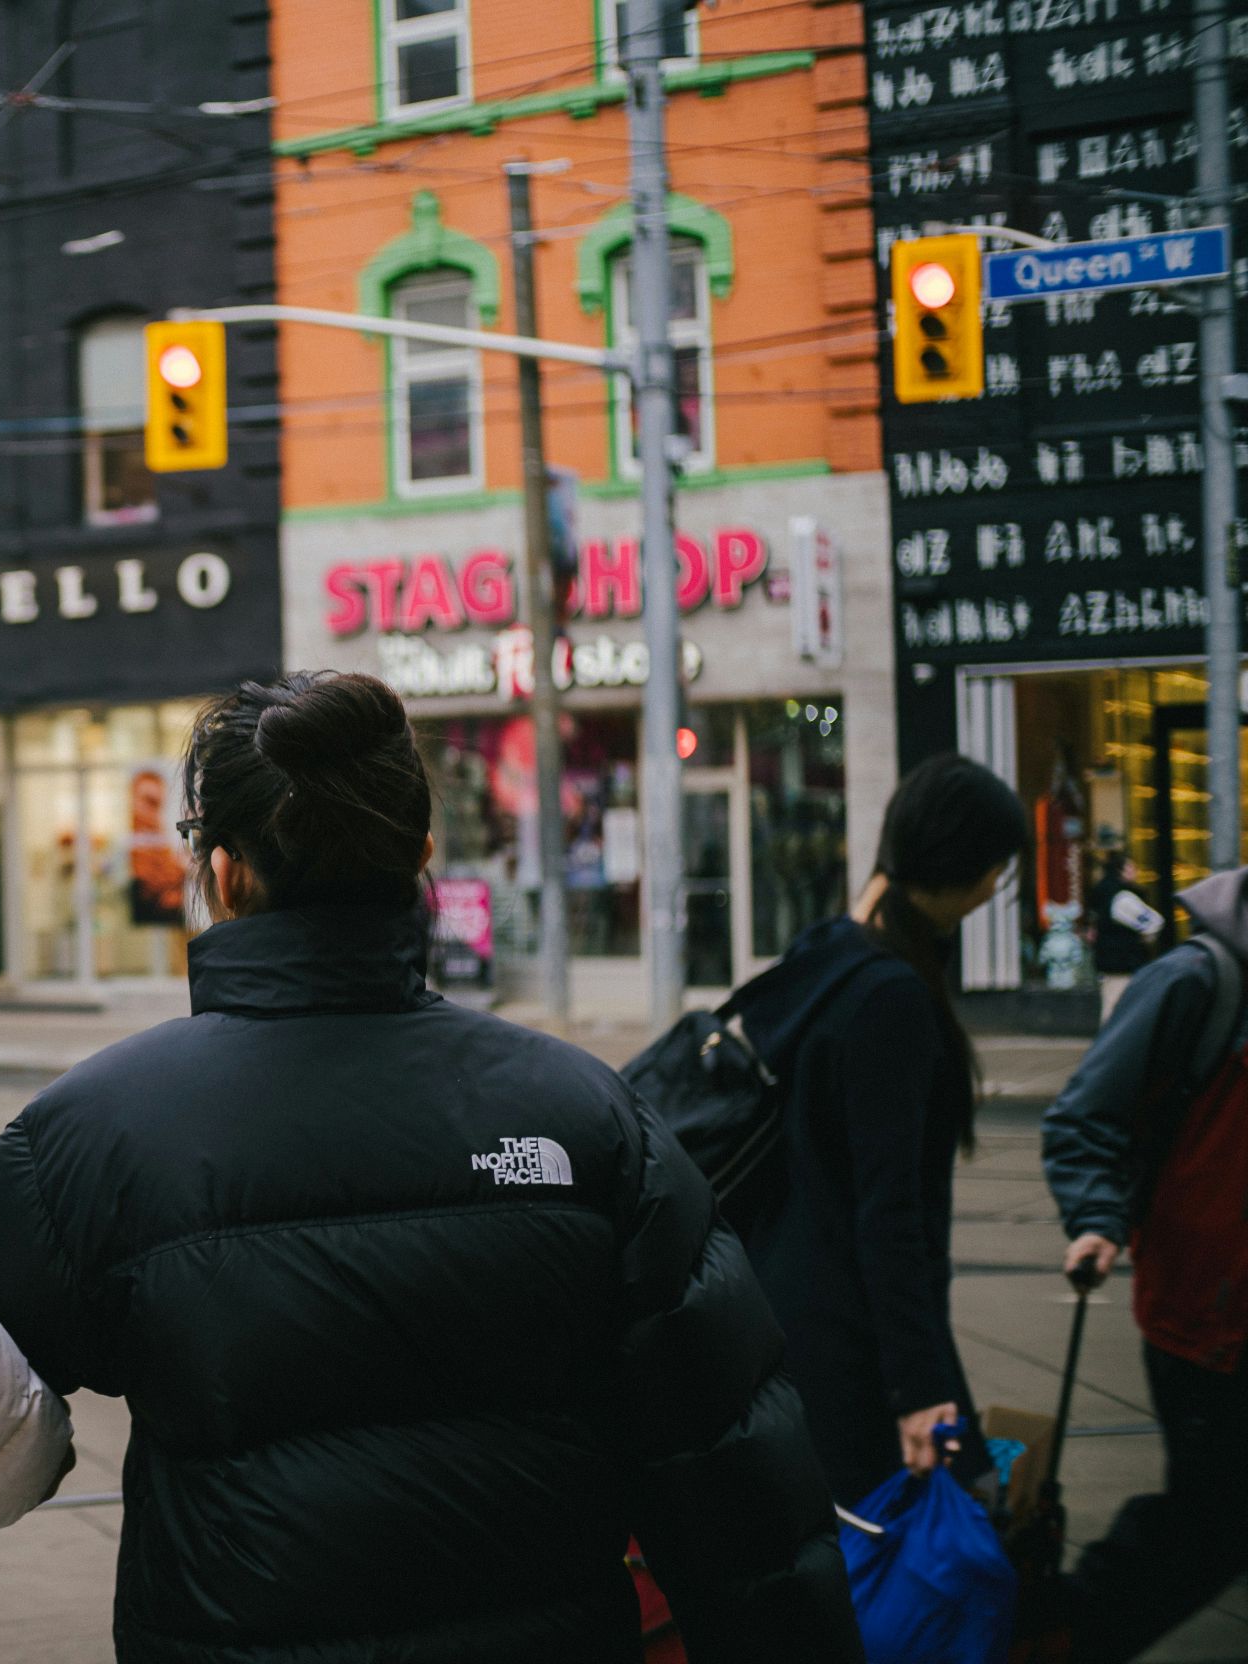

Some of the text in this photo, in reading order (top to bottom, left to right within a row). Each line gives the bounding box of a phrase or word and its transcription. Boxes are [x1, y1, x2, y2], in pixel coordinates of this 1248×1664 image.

[1014, 251, 1132, 290] Queen
[1162, 236, 1196, 271] W
[324, 548, 516, 634] STAG
[567, 528, 767, 618] HOP
[499, 1136, 539, 1154] THE
[471, 1152, 541, 1170] NORTH
[493, 1167, 543, 1185] FACE
